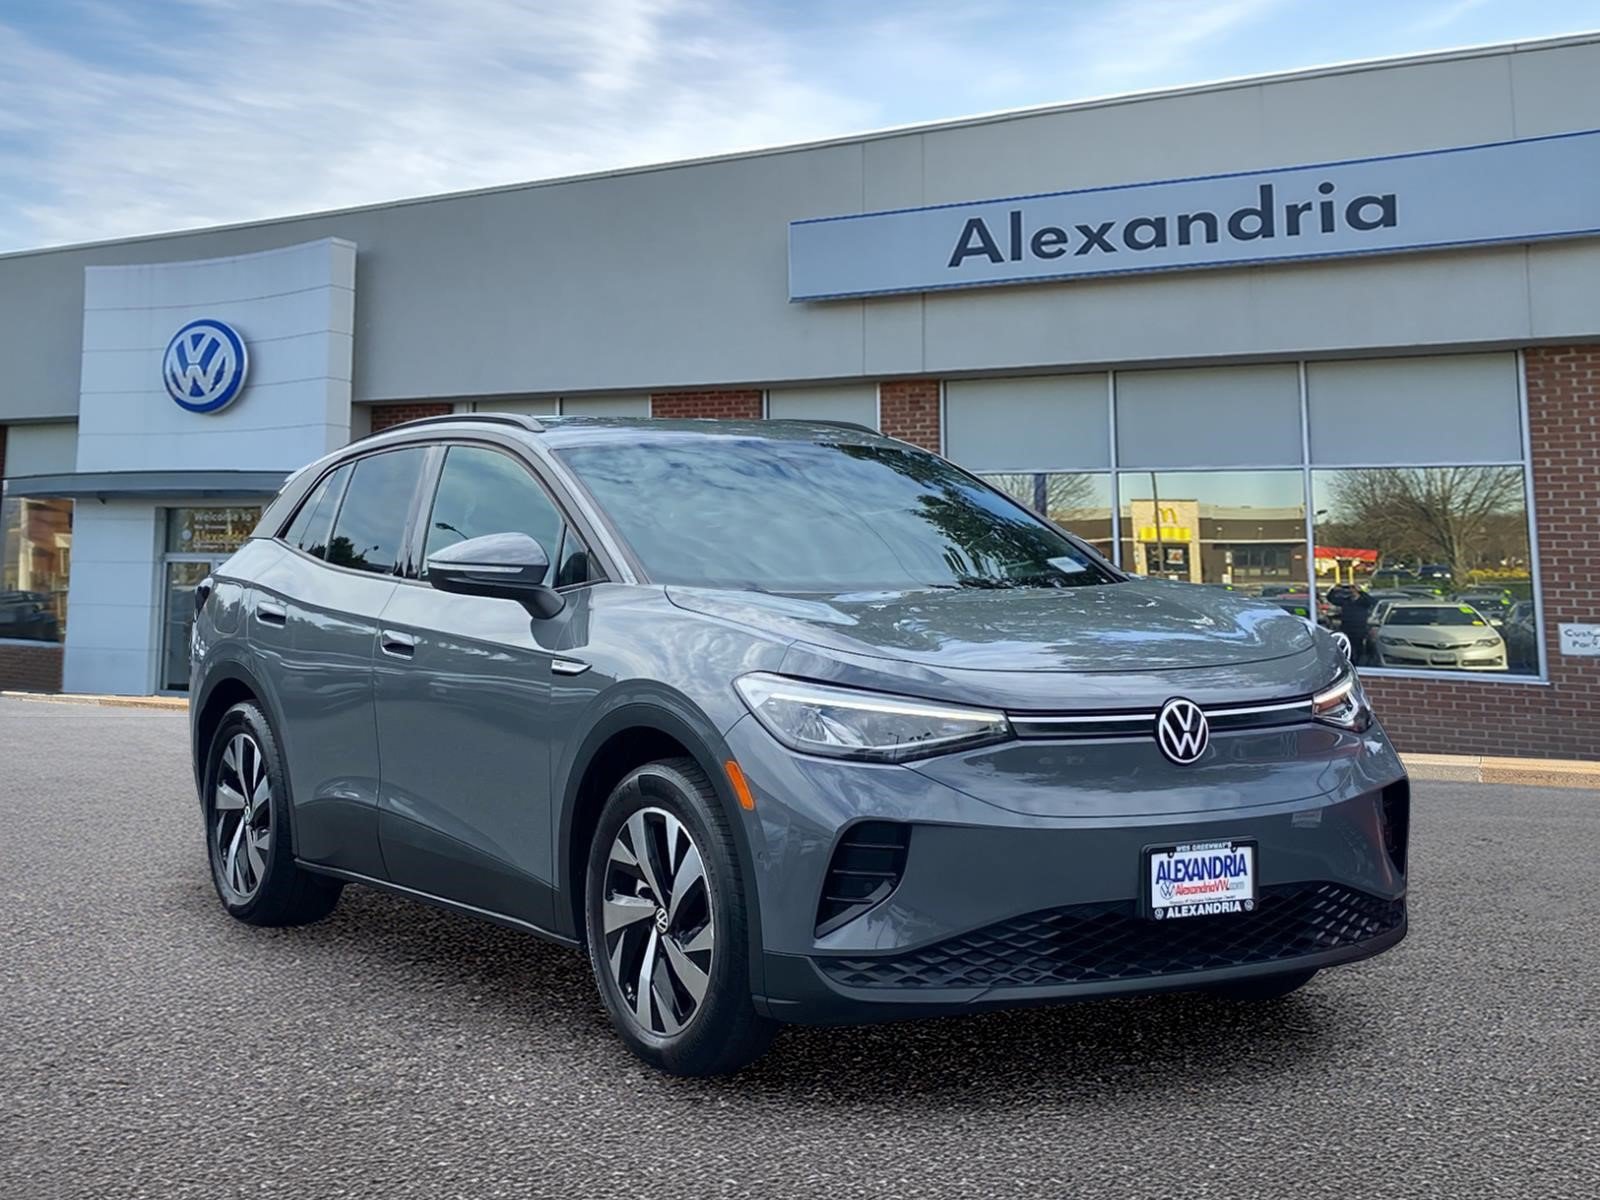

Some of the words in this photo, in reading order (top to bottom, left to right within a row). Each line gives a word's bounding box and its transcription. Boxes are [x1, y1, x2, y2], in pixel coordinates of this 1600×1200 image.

[947, 181, 1399, 269] Alexandria
[1159, 699, 1209, 763] VW
[1156, 853, 1248, 884] ALEXANDRIA
[1166, 900, 1241, 919] ALEXANDRIA
